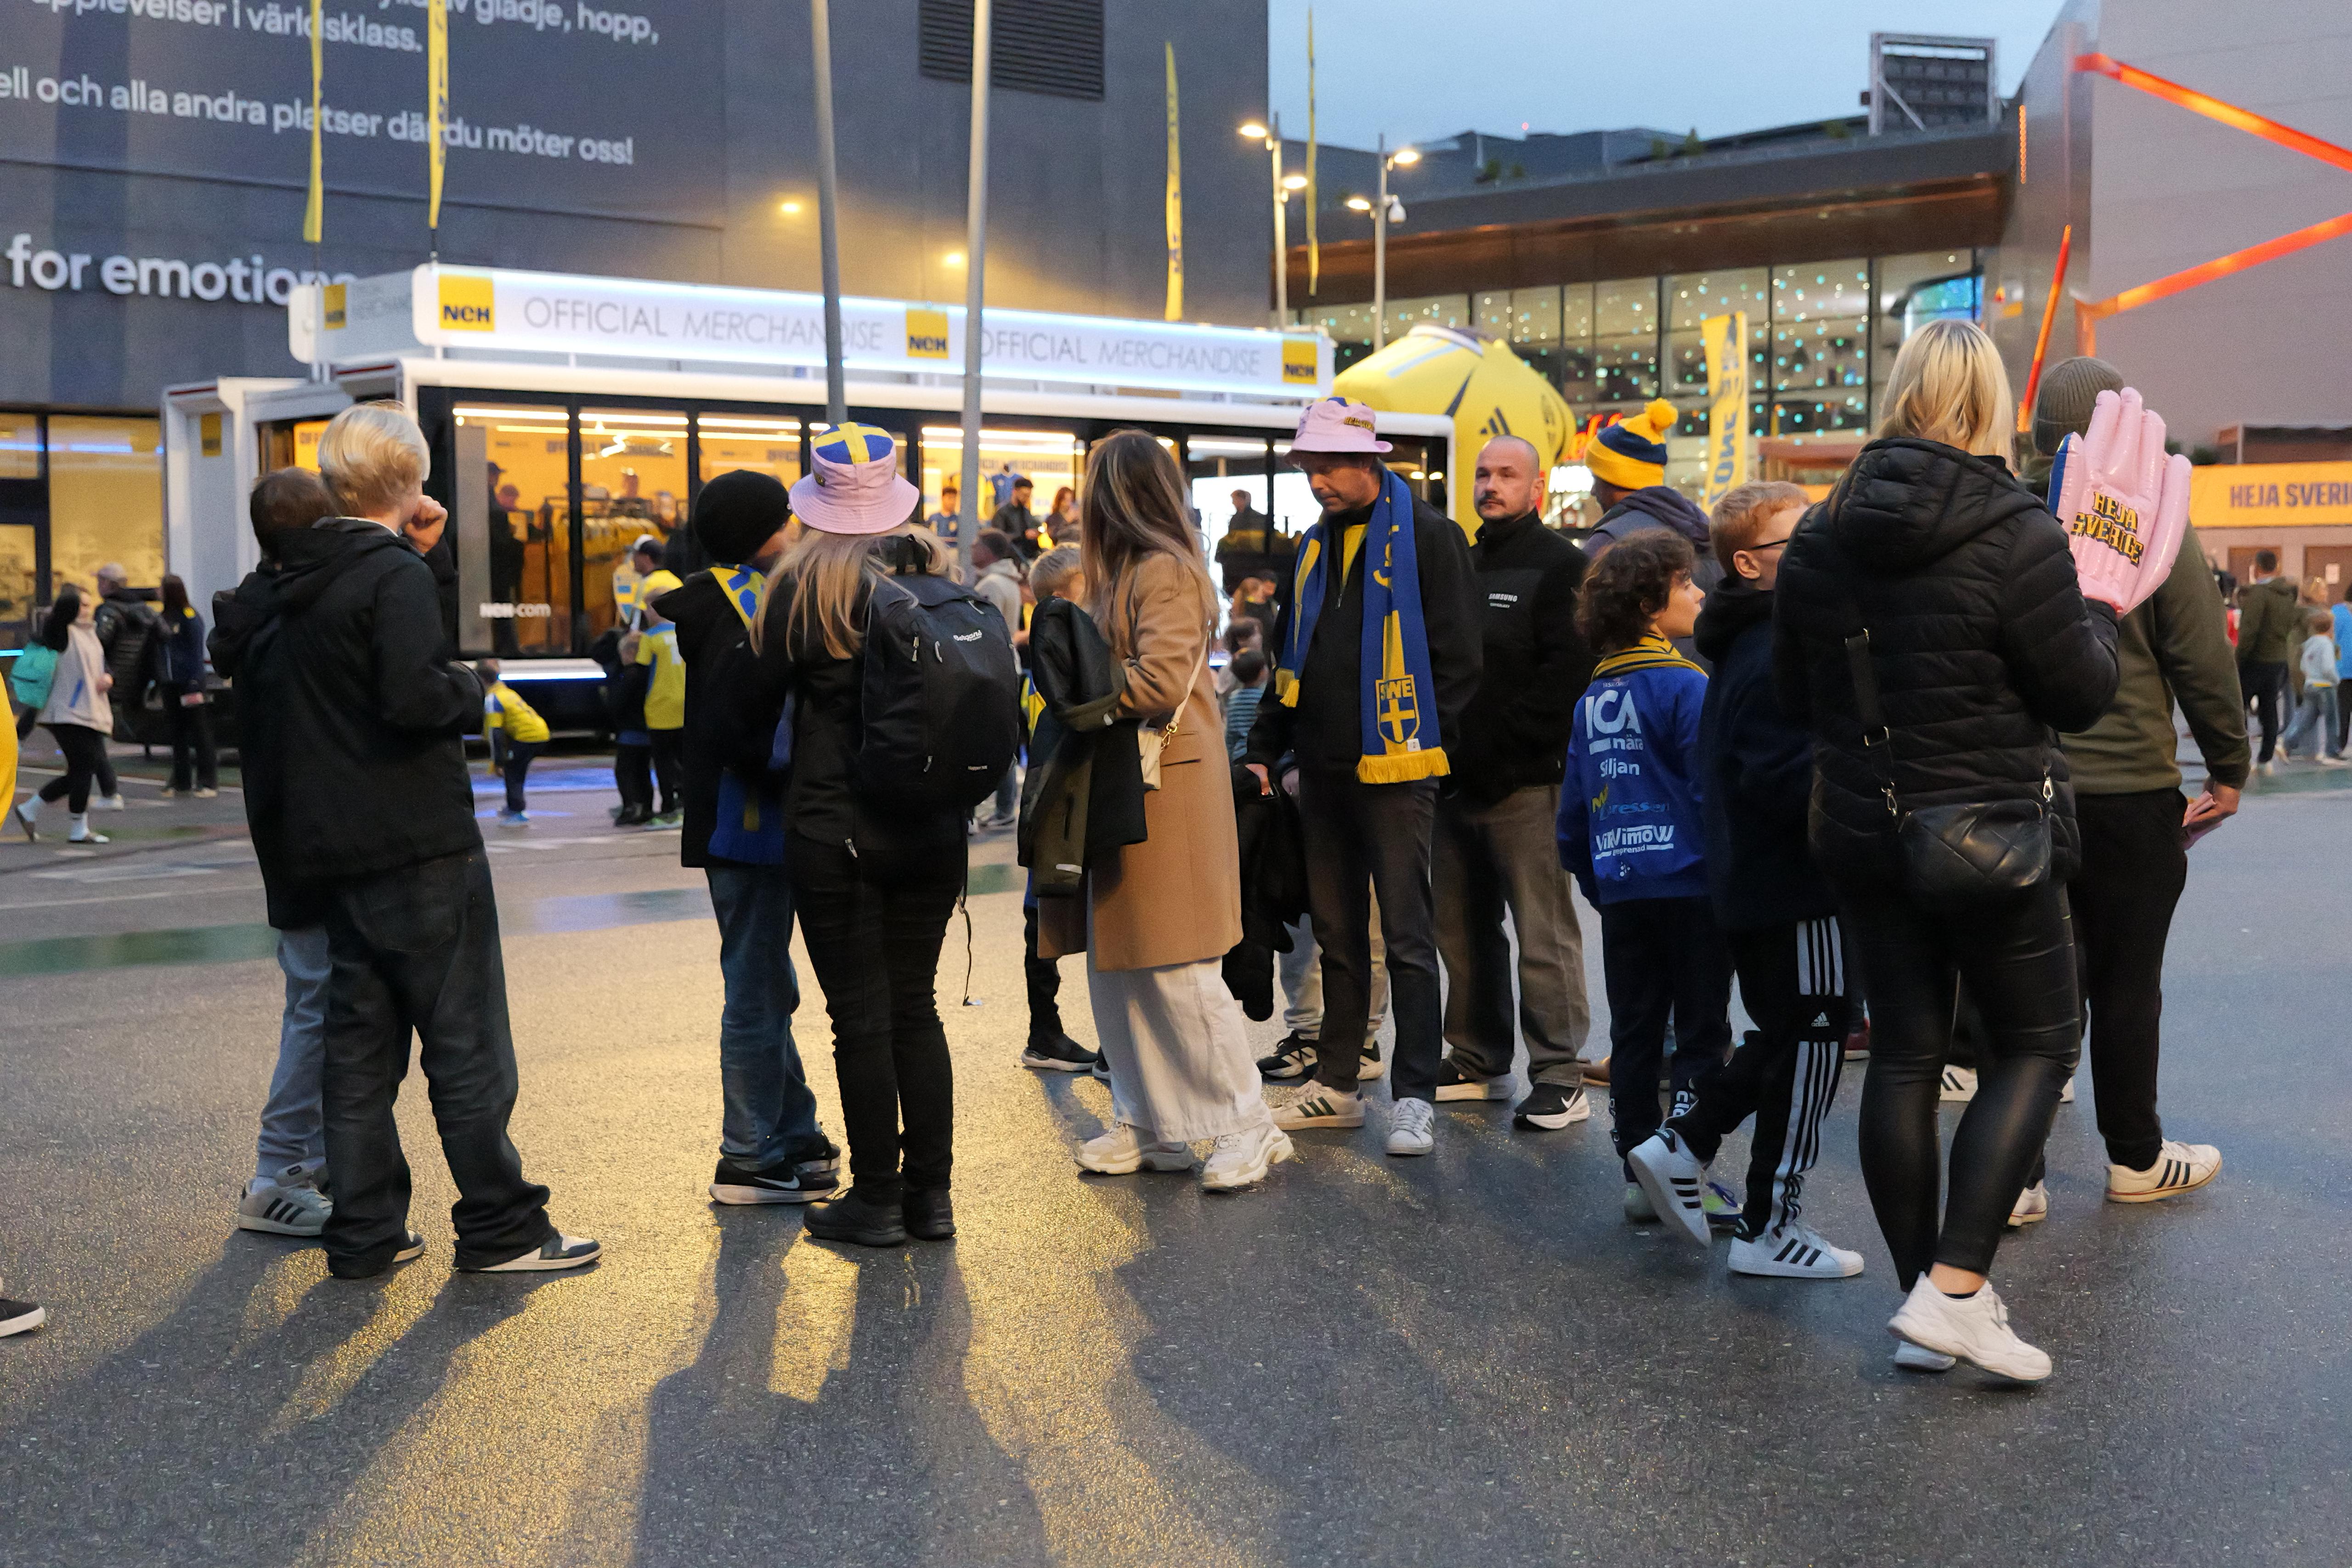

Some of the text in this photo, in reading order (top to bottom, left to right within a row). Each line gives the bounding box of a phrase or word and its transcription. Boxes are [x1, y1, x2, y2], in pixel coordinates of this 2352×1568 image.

[577, 1, 659, 45] hopp,
[36, 74, 102, 108] och
[110, 80, 168, 115] alla
[173, 91, 266, 125] andra
[273, 98, 382, 137] platser
[445, 117, 482, 149] du
[488, 125, 573, 158] möter
[579, 137, 633, 165] oss!
[6, 234, 91, 289] for
[524, 297, 668, 337] OFFICIAL
[1099, 340, 1261, 377] MERCHANDISE
[2092, 492, 2138, 535] HEJA
[2230, 484, 2279, 507] HEJA
[2070, 512, 2144, 568] SVERIGE
[1488, 593, 1518, 602] SAMSUNG
[953, 629, 982, 641] Bergans
[1585, 690, 1641, 739] ICA
